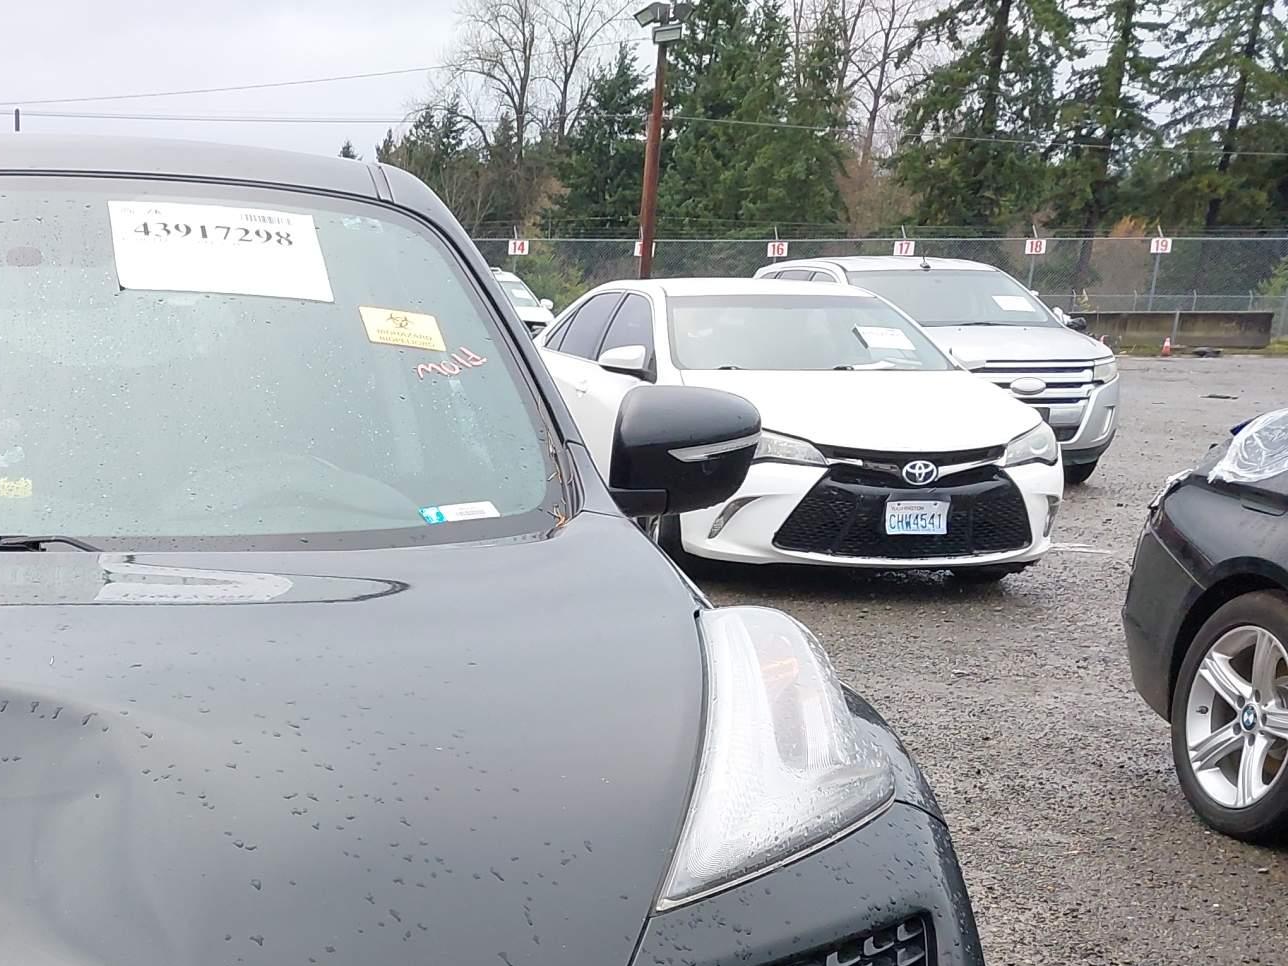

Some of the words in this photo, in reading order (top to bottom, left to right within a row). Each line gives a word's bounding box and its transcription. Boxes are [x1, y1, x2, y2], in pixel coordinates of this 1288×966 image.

[134, 221, 294, 246] 43917298
[512, 241, 526, 254] 14
[770, 242, 786, 256] 16
[897, 241, 913, 254] 17
[1028, 240, 1043, 253] 18
[1154, 239, 1170, 252] 19
[889, 513, 942, 530] CHW4541
